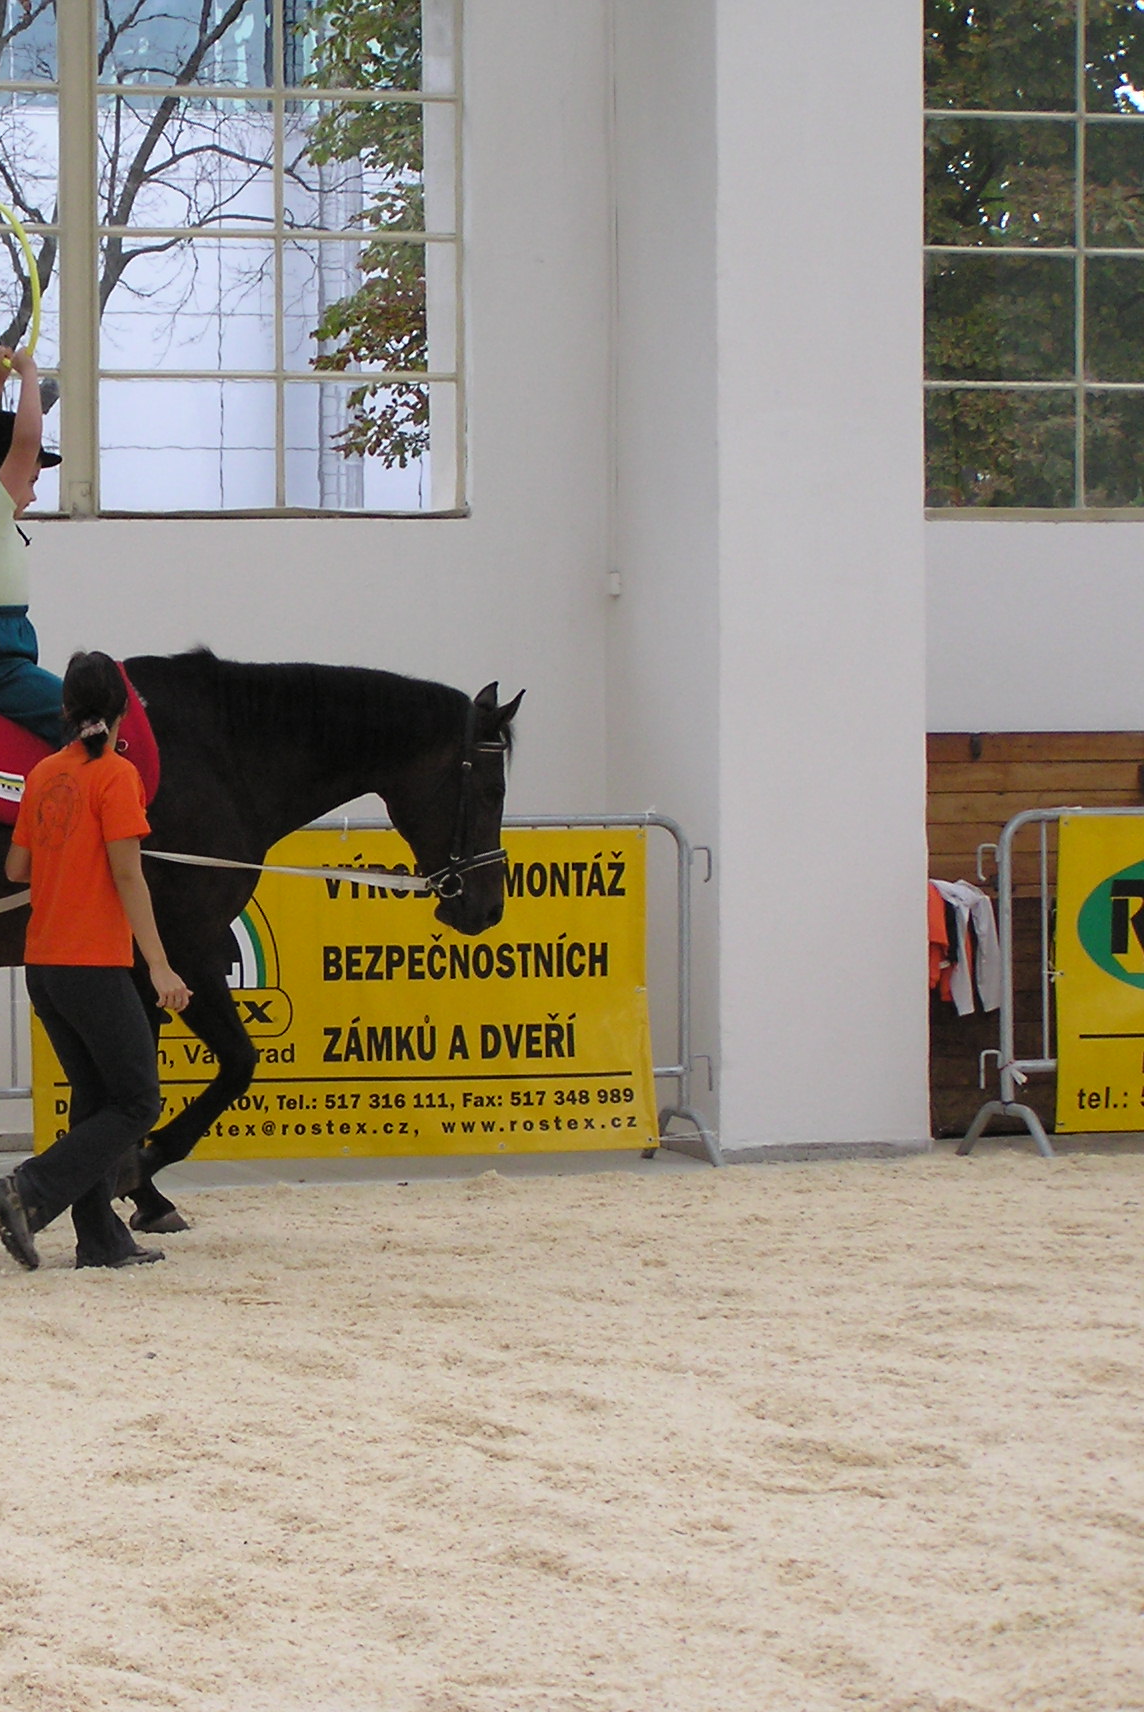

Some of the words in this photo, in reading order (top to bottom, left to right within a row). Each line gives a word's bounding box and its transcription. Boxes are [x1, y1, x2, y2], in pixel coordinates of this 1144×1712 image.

[503, 851, 626, 897] MONTÁŽ
[323, 933, 609, 981] BEZPEČNOSTNÍCH
[323, 1015, 436, 1062] ZÁMKŮ
[448, 1025, 469, 1060] A
[481, 1012, 576, 1059] DVEŘÍ
[277, 1094, 317, 1110] Tel.:
[325, 1094, 360, 1109] 517
[369, 1094, 406, 1109] 316
[413, 1093, 455, 1111] 111,
[463, 1092, 503, 1108] Fax:
[511, 1091, 546, 1107] 517
[554, 1090, 590, 1105] 348
[597, 1088, 634, 1103] 989
[1077, 1087, 1128, 1110] tel.:
[442, 1115, 638, 1134] www.rostex.cz
